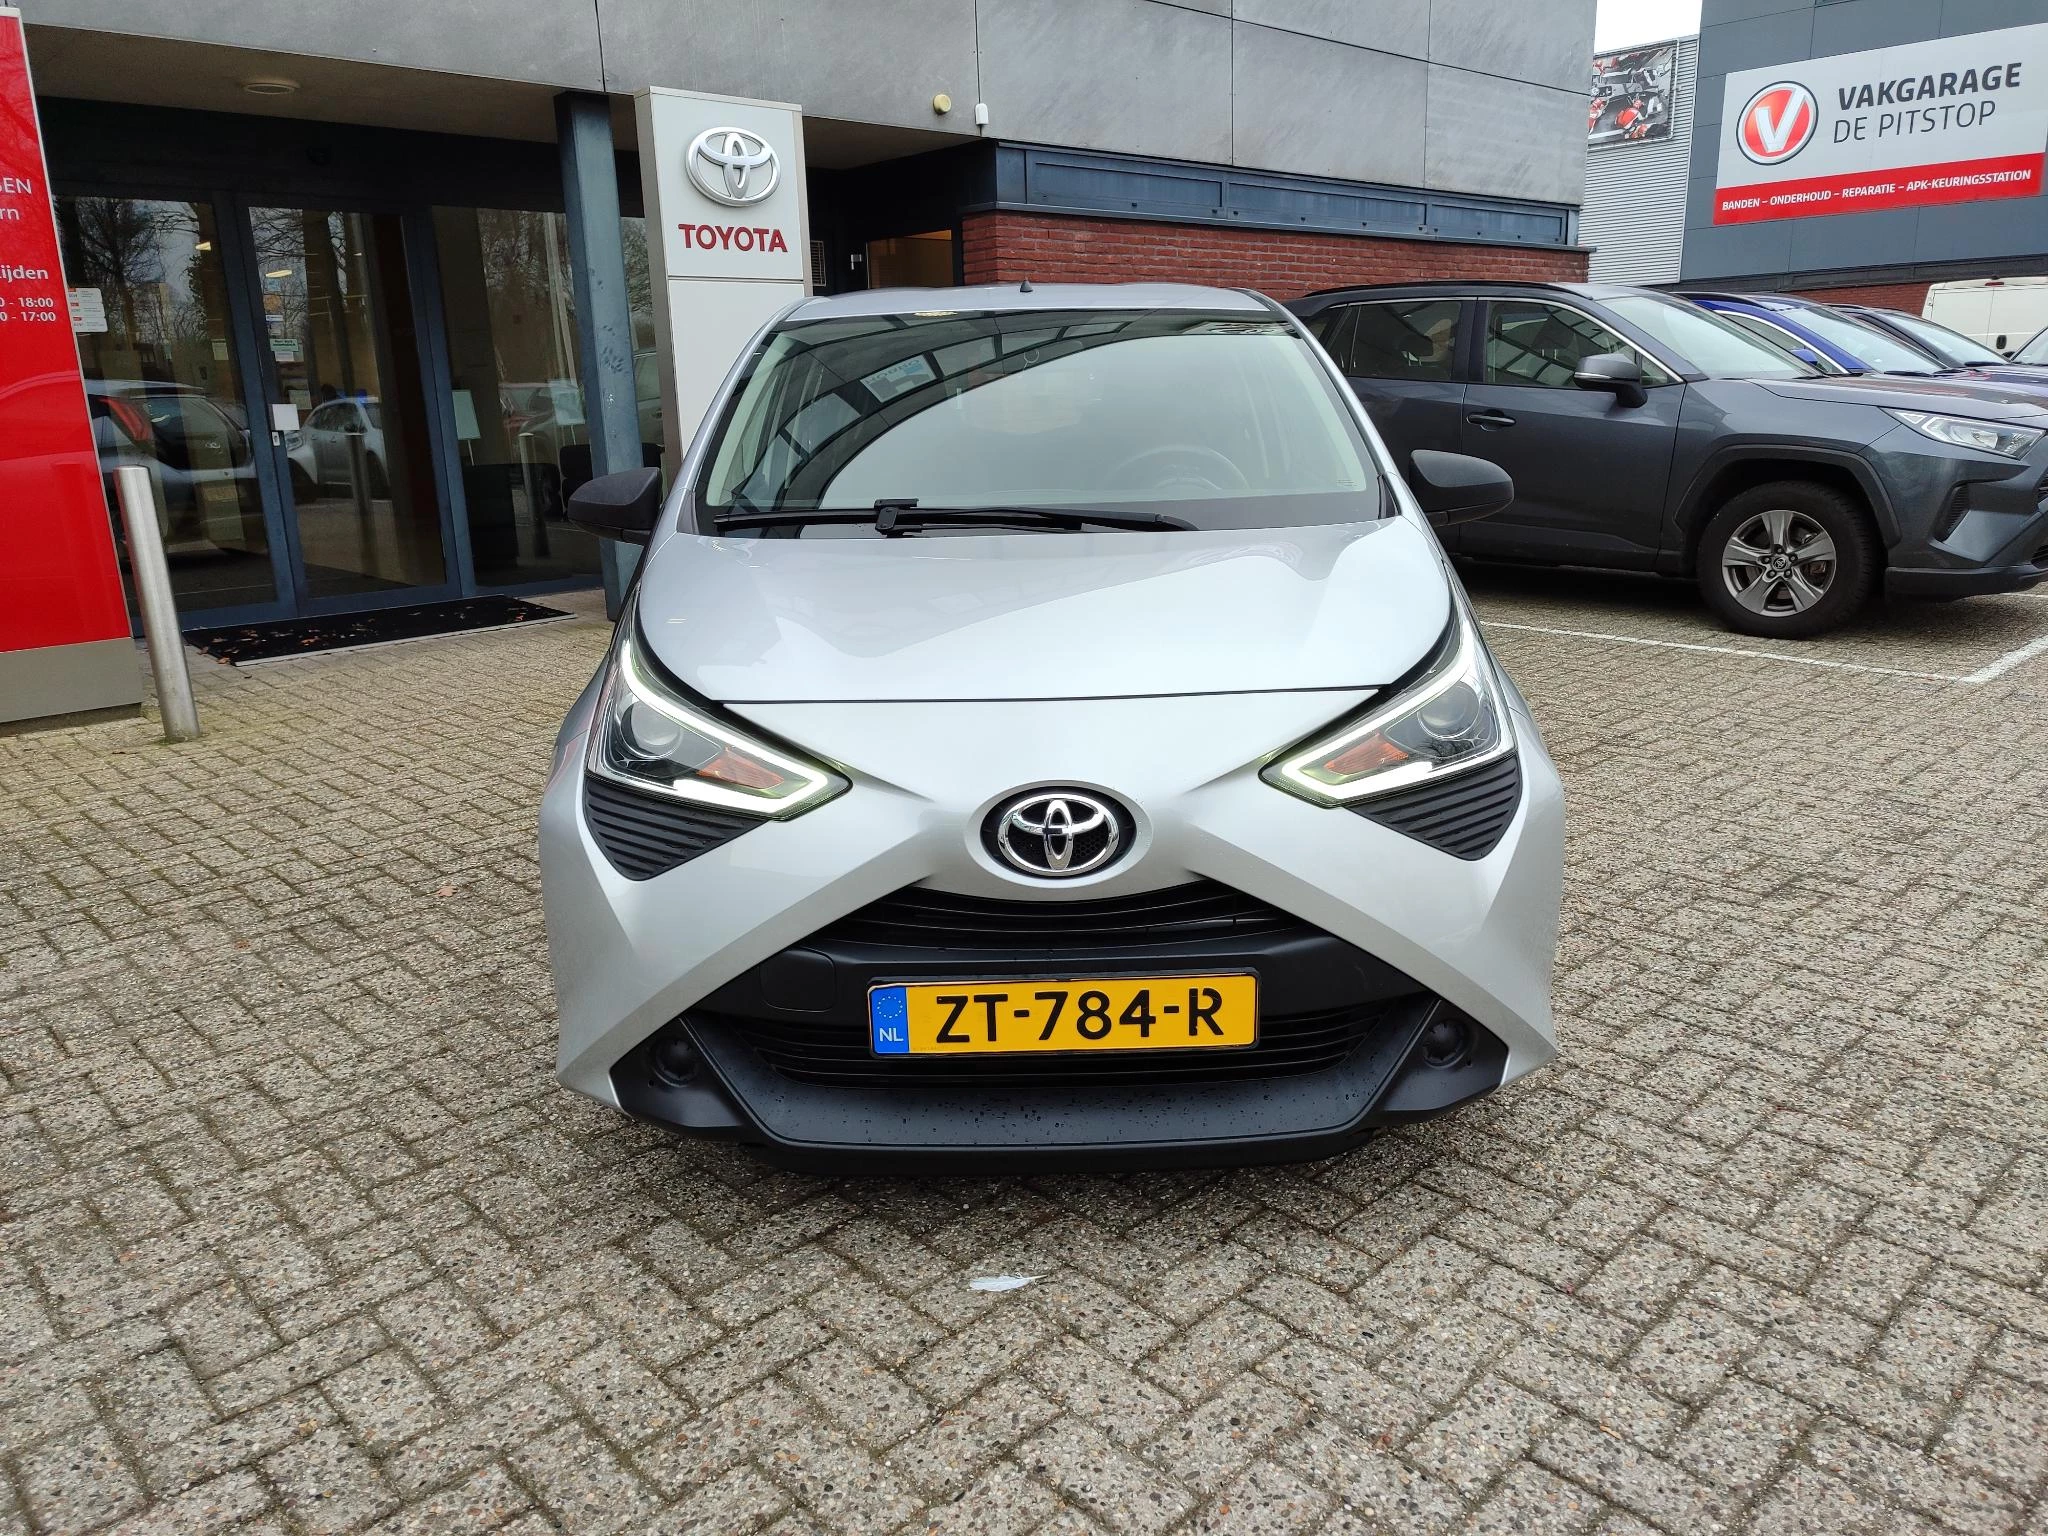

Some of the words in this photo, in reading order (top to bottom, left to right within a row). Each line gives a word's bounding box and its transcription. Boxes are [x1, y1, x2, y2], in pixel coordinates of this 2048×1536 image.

[1838, 62, 2022, 111] VAKGARAGE
[1833, 116, 1868, 144] DE
[1878, 100, 1996, 138] PITSTOP
[0, 177, 32, 195] EN
[1721, 197, 1760, 211] BANDEN
[1769, 190, 1832, 206] ONDERHOUD
[1842, 183, 1896, 198] REPARATIE
[1906, 169, 2032, 192] APK-KEURINGSSTATION
[677, 223, 788, 253] TOYOTA
[0, 264, 49, 283] ijden
[18, 297, 54, 308] 18:00
[20, 311, 56, 322] 17:00
[936, 987, 1224, 1044] ZT-784-R
[879, 1026, 904, 1043] NL
